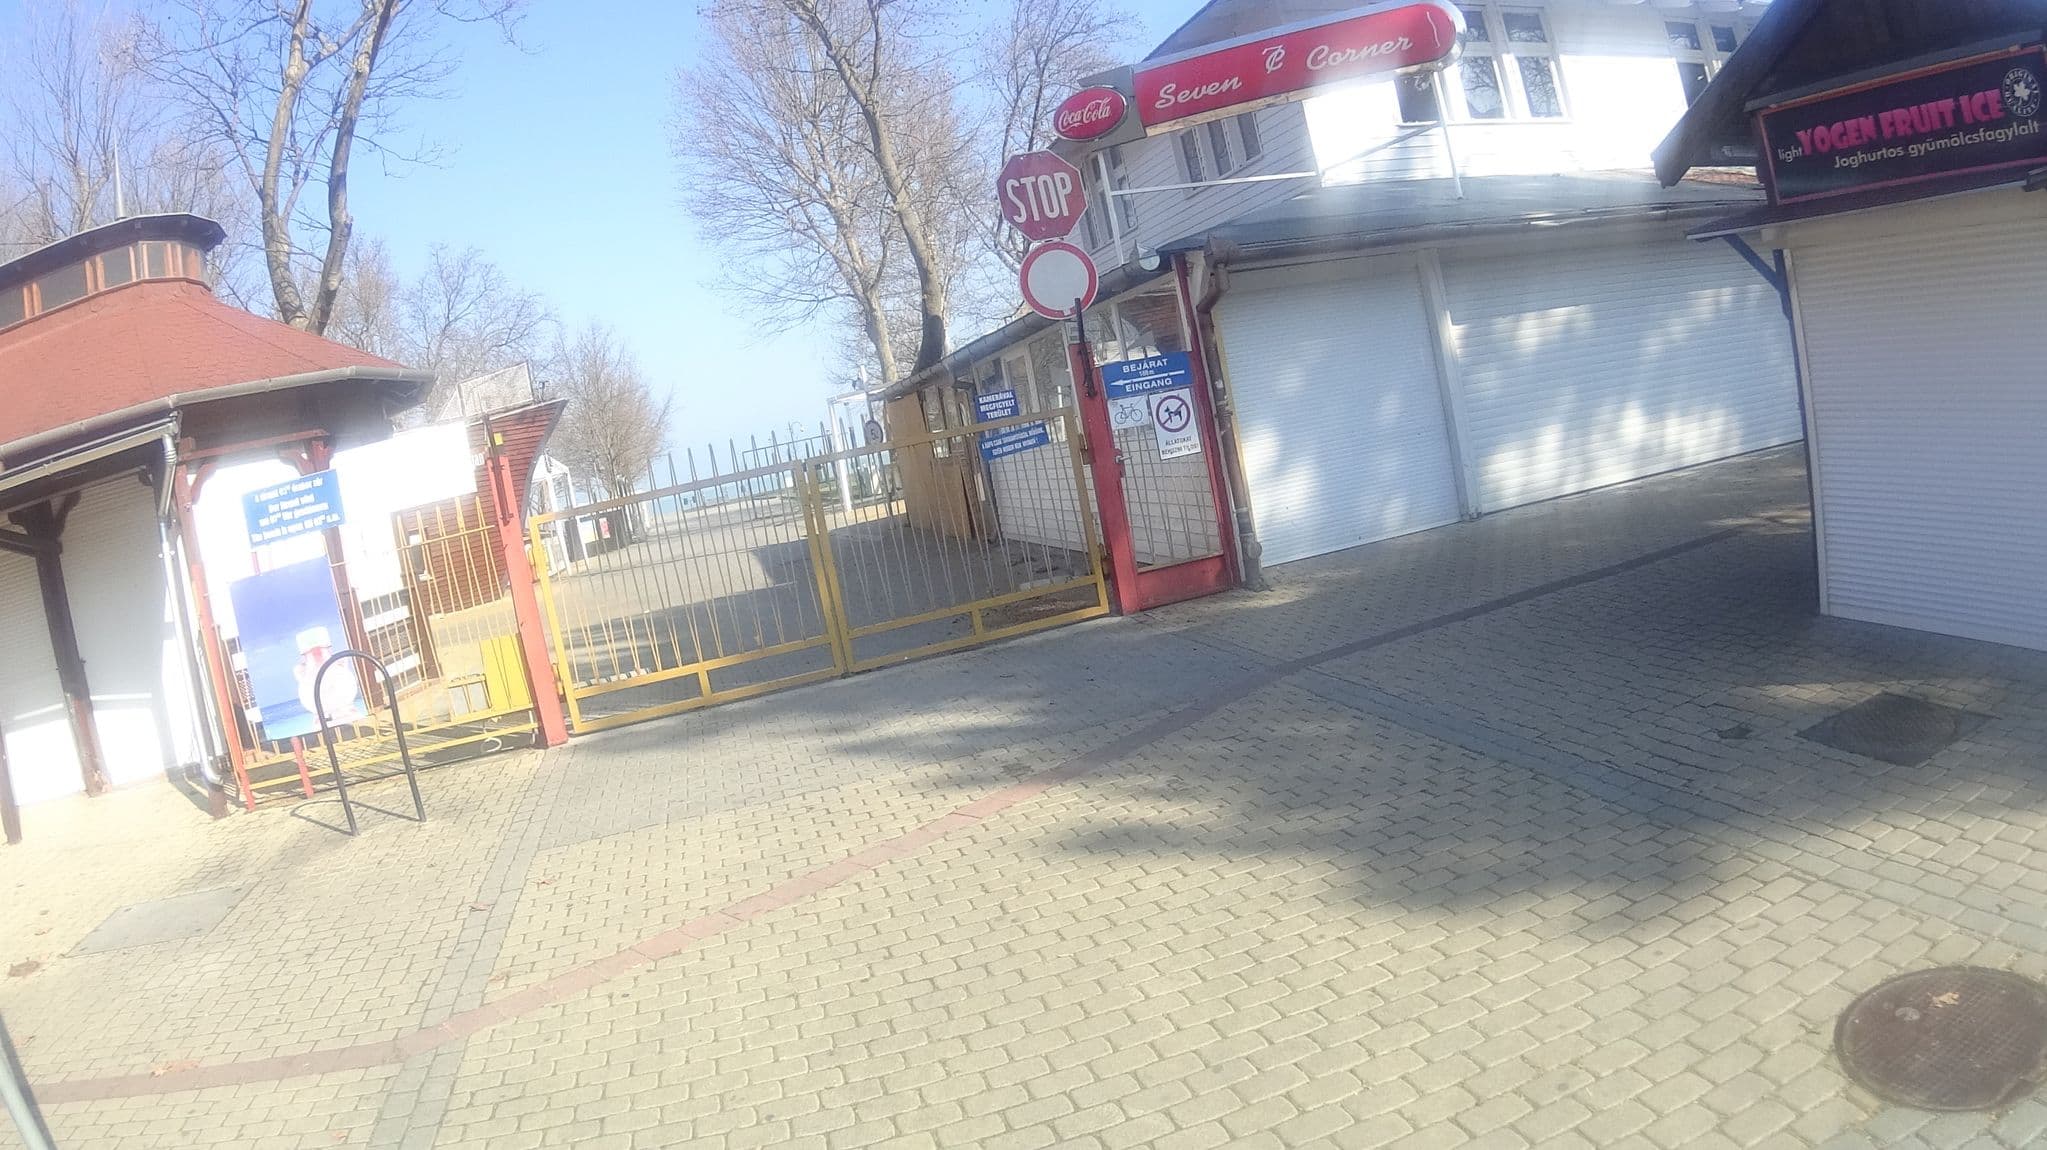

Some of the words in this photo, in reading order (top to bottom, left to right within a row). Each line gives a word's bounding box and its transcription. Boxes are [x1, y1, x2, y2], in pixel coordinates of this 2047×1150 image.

[1155, 75, 1243, 110] Seven
[1306, 35, 1413, 71] Corner
[1058, 96, 1112, 132] Coca-Cola
[1778, 145, 1803, 163] light
[1795, 115, 1877, 156] YOGEN
[1878, 98, 1955, 140] FRUIT
[1959, 88, 2006, 125] ICE
[1834, 145, 1905, 169] Joghurtos
[1908, 119, 2041, 158] gyümölcsfagylalt
[1005, 172, 1073, 224] STOP
[1122, 358, 1168, 373] BEJÁRAT
[978, 391, 1014, 404] KAMERÁVAL
[1125, 378, 1172, 392] EINGANG
[979, 399, 1016, 412] MEGFIGYELT
[986, 408, 1012, 419] TERÜLET
